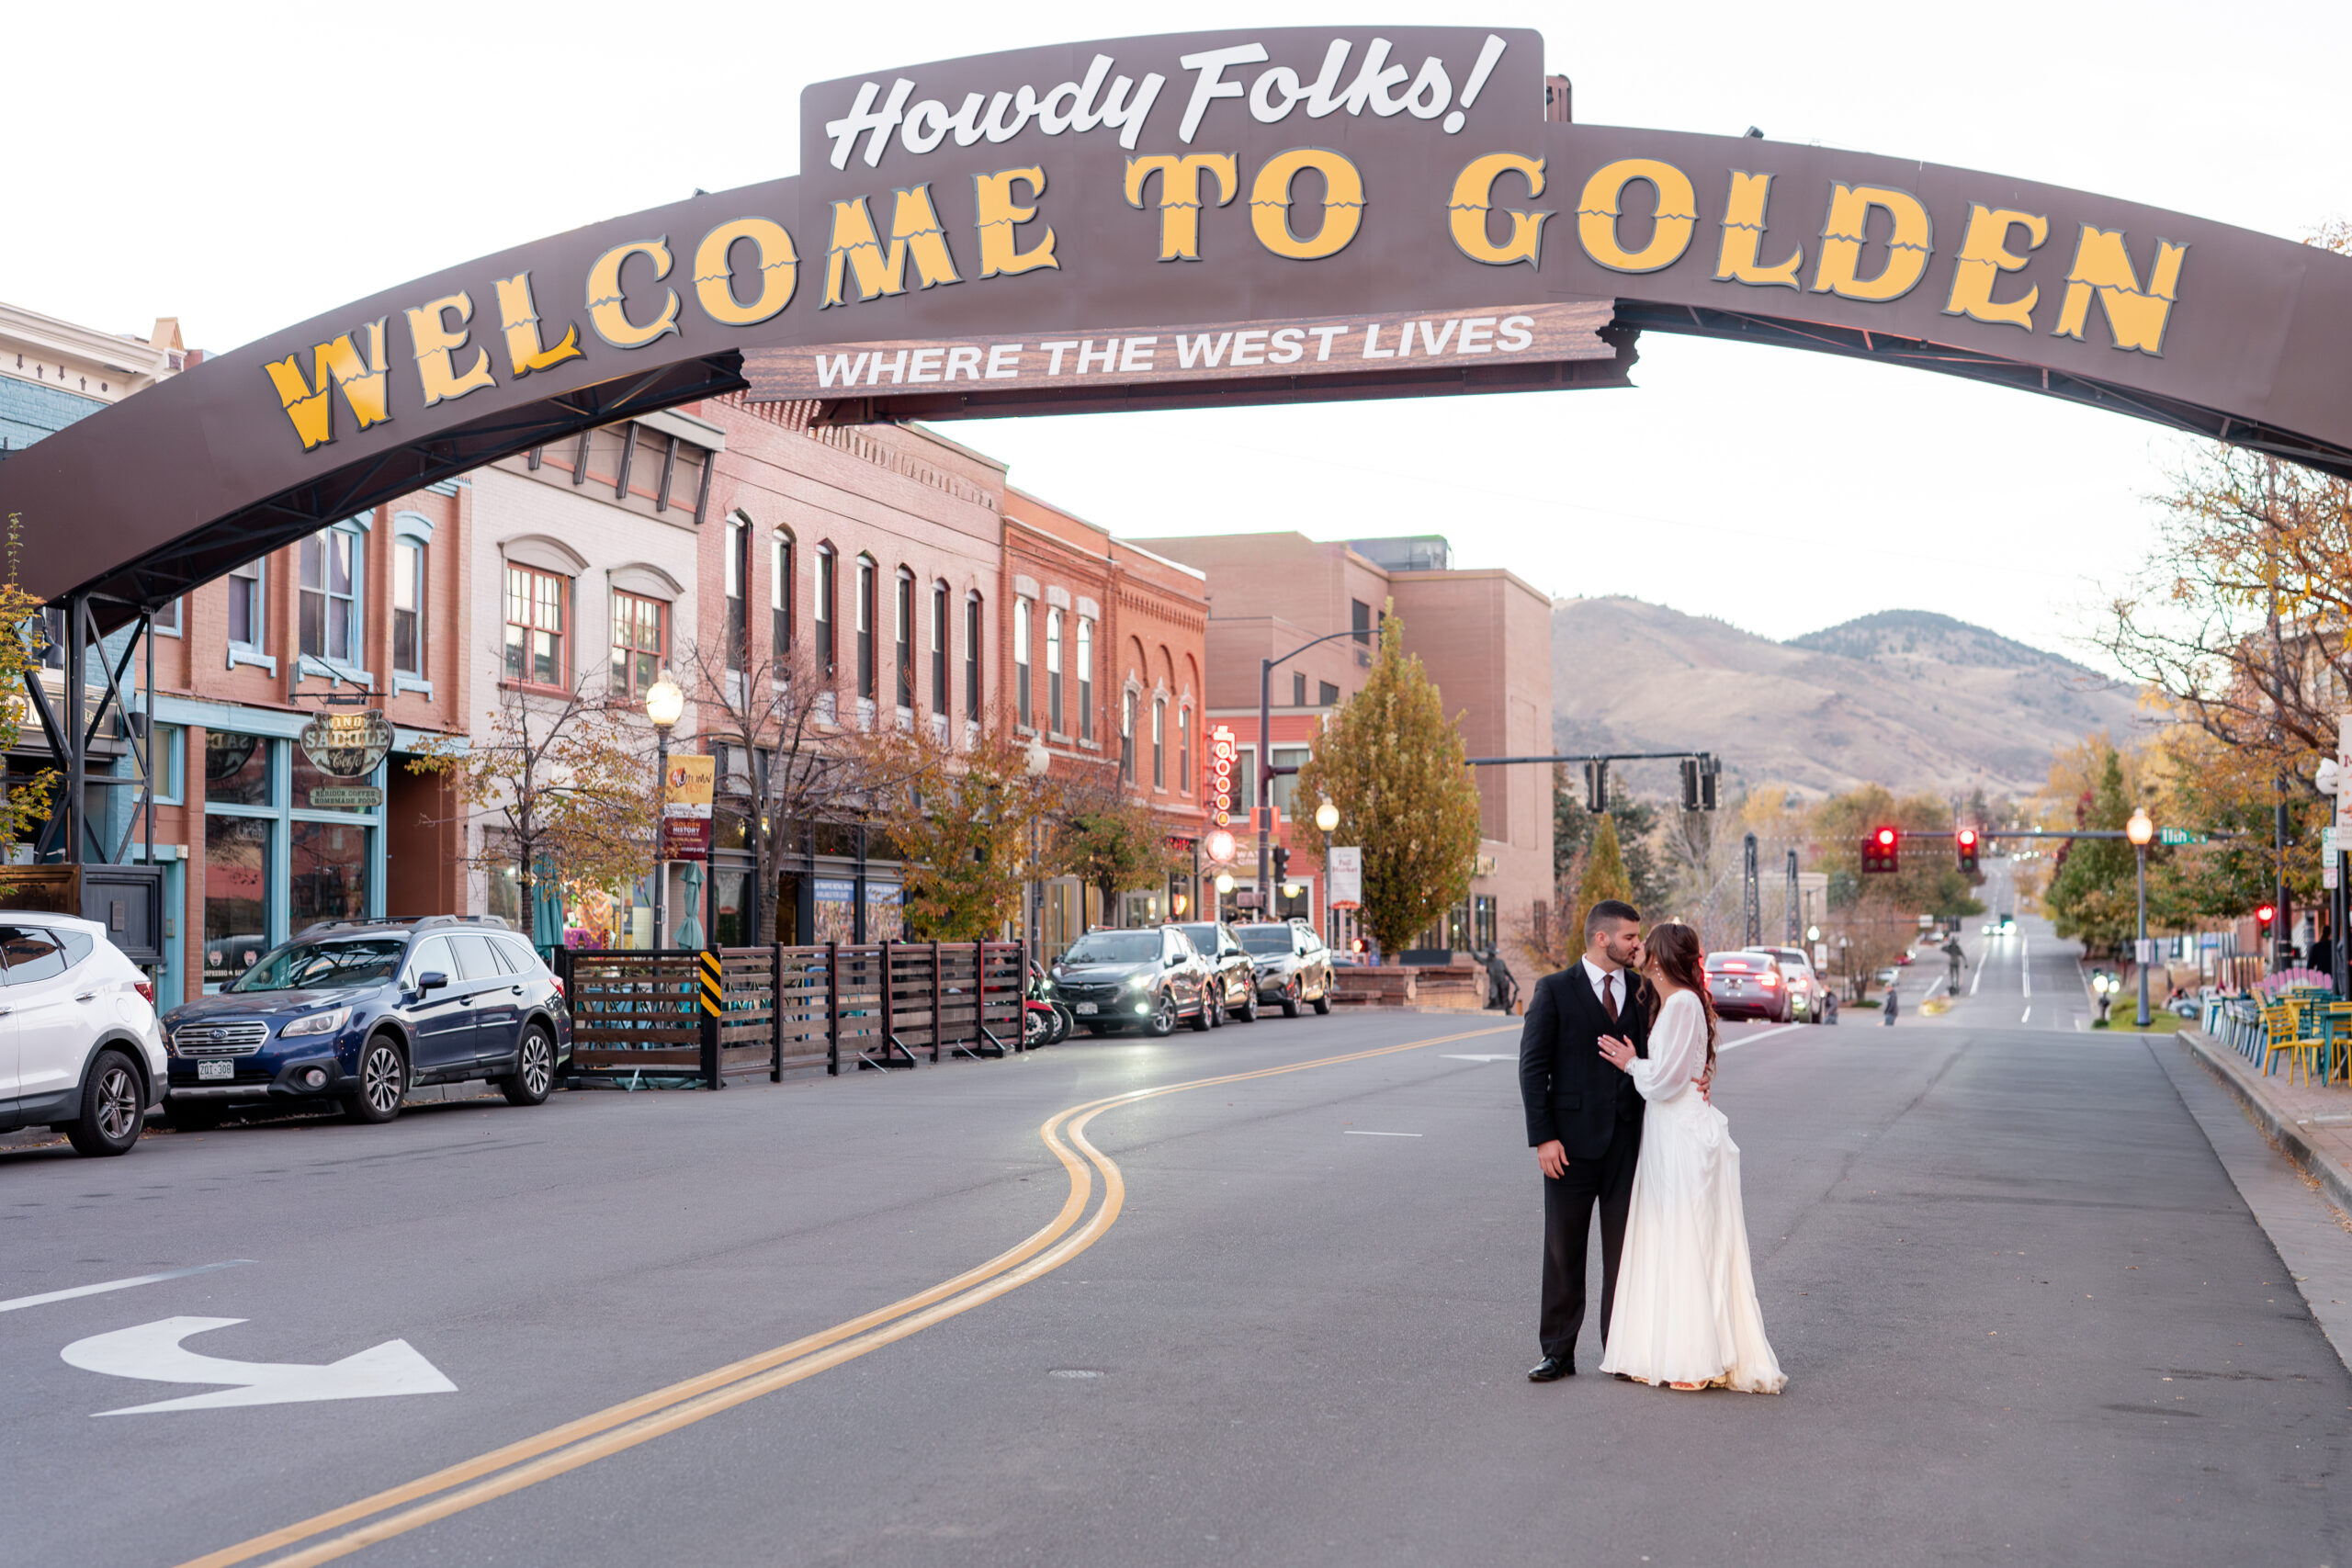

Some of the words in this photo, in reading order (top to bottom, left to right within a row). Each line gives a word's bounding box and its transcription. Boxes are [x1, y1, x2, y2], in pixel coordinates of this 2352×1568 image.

[826, 53, 1167, 171] Howdy
[1178, 34, 1507, 143] Folks!
[264, 163, 1061, 454] WELCOME
[1123, 146, 1367, 262] TO
[1446, 151, 2192, 358] GOLDEN
[815, 344, 1022, 389] WHERE
[1039, 336, 1158, 374] THE
[1175, 325, 1349, 368] WEST
[1362, 315, 1535, 360] LIVES
[305, 729, 388, 748] SADDLE
[322, 716, 371, 729] WINDY
[672, 770, 712, 787] AUTUMN
